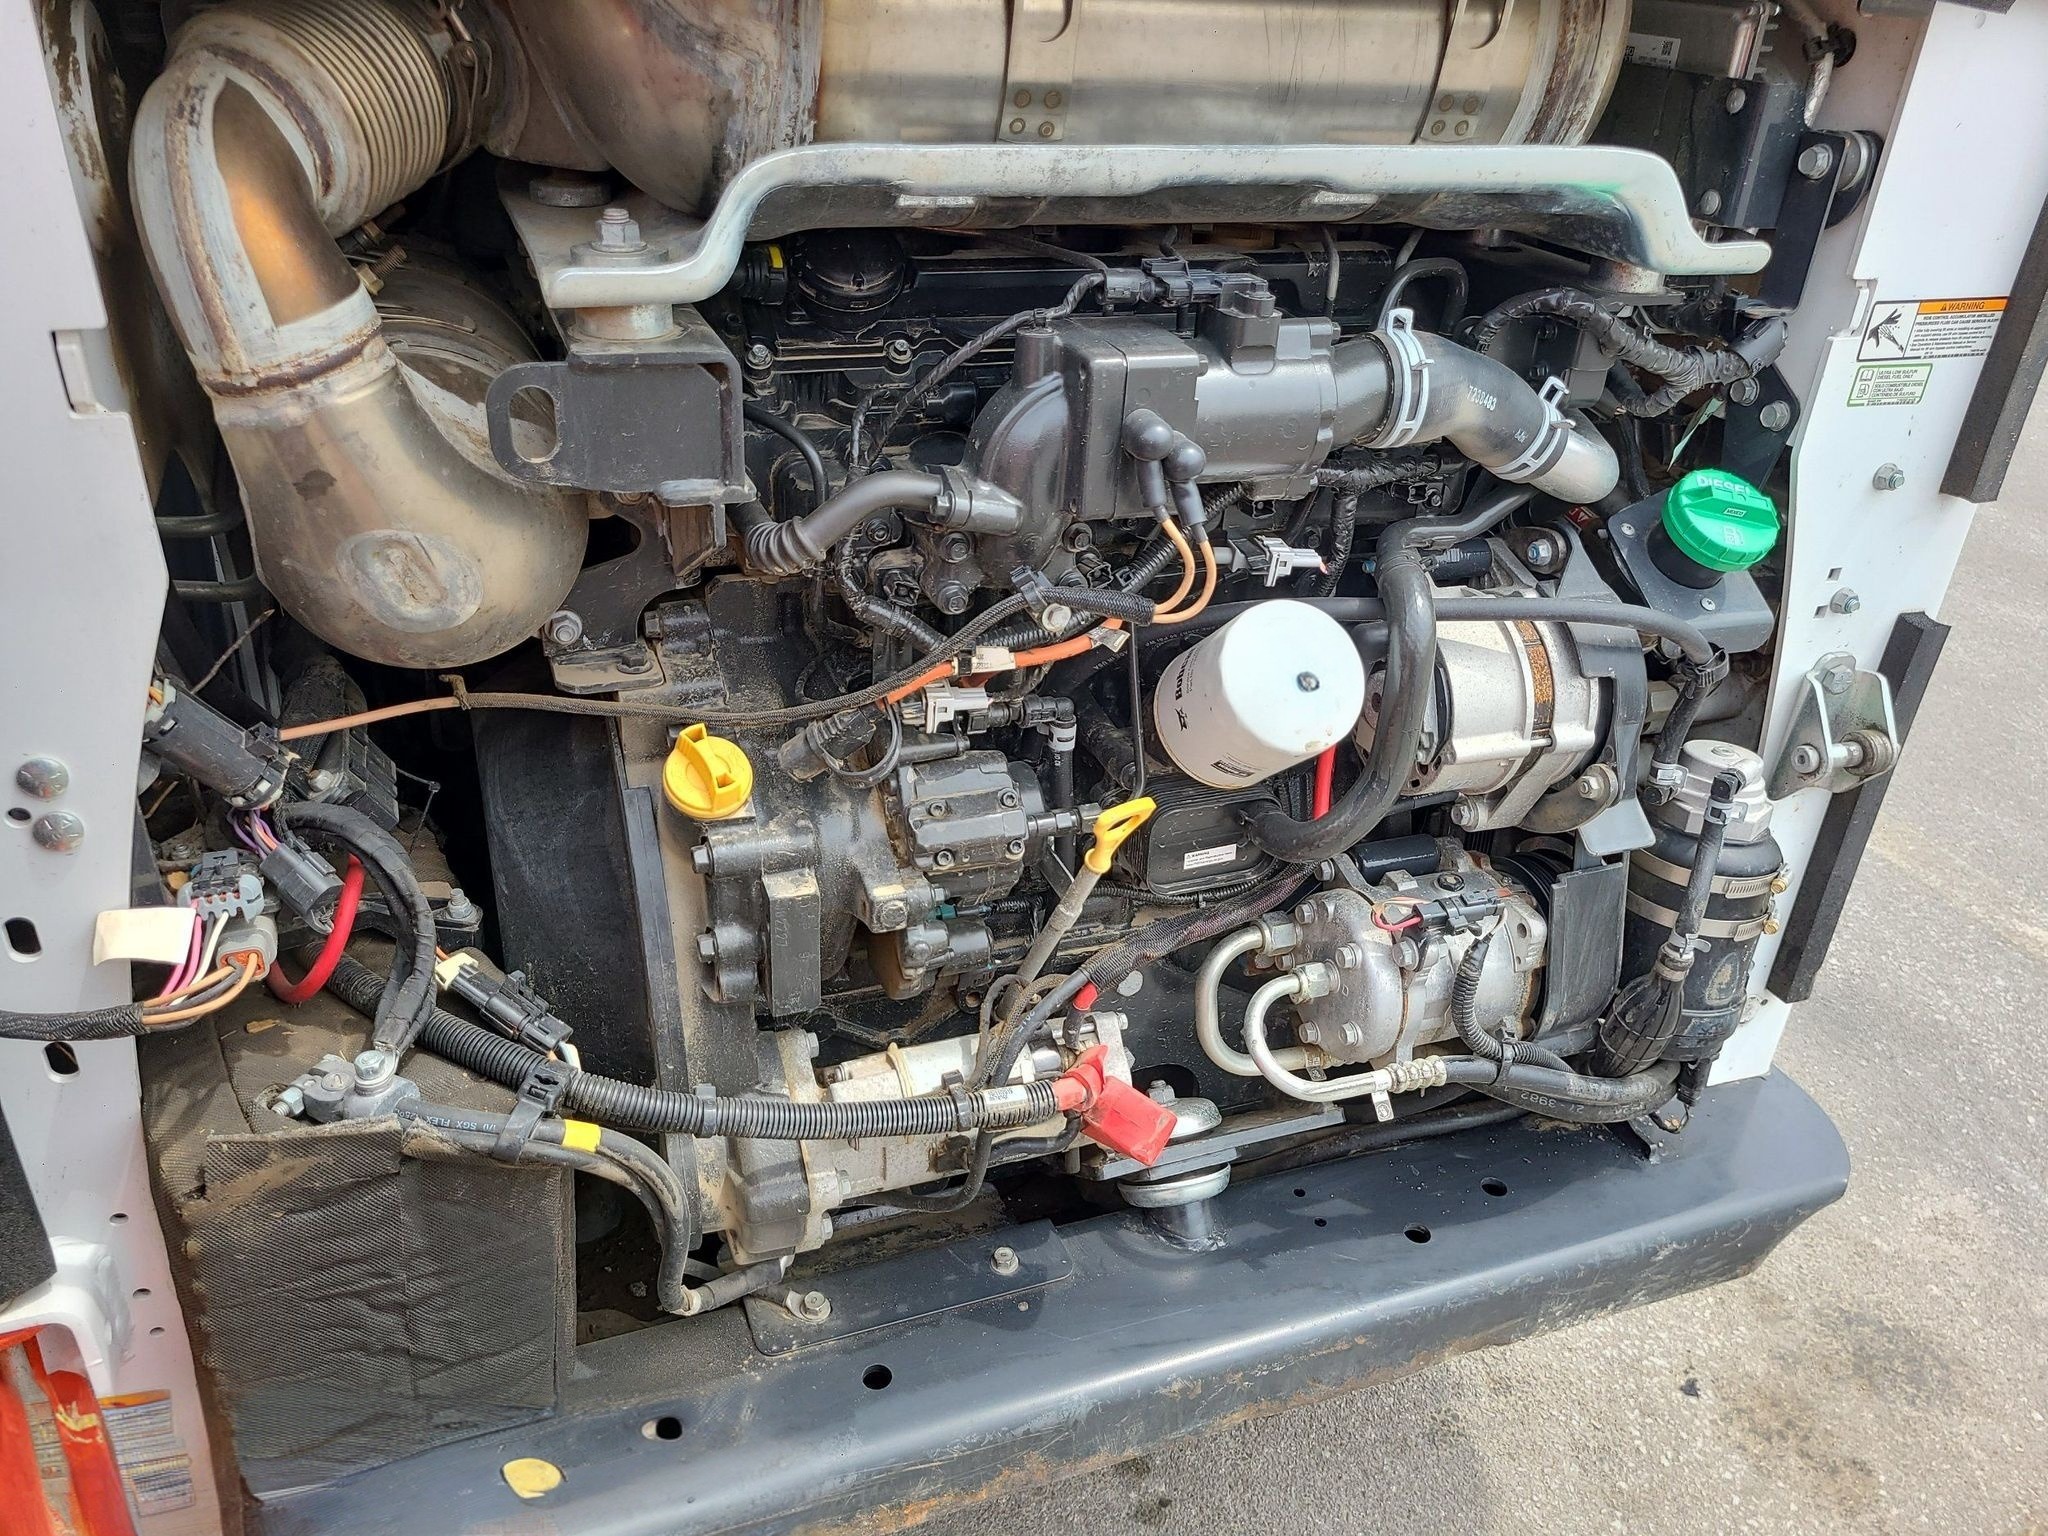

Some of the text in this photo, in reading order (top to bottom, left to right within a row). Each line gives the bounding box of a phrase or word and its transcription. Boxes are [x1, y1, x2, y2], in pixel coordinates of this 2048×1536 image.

[1948, 302, 1985, 311] WARNING
[426, 1115, 451, 1127] FLEX
[455, 1120, 477, 1130] SGX
